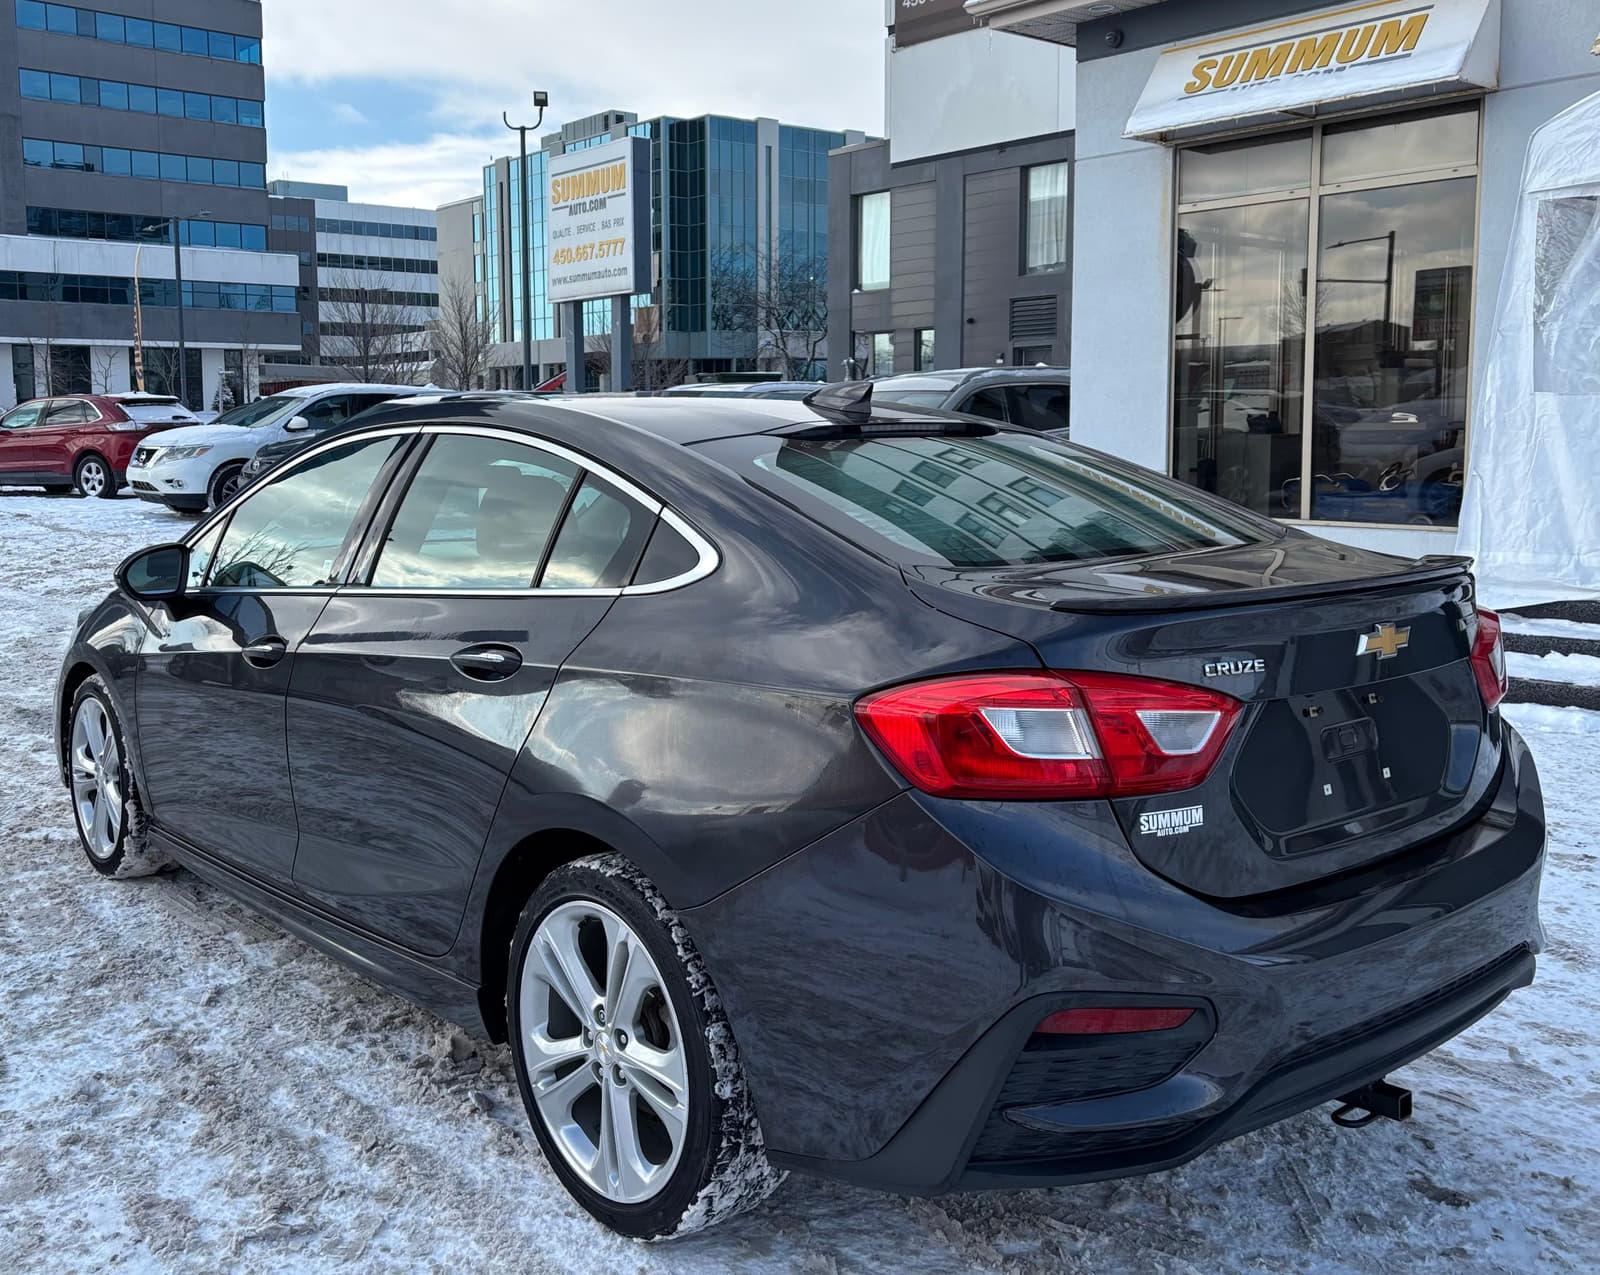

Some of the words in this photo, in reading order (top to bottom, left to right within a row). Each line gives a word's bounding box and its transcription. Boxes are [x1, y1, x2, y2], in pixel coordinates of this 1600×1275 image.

[1184, 14, 1429, 94] SUMMUM
[552, 163, 625, 204] SUMMUM
[568, 197, 607, 216] AUTO.COM
[576, 222, 596, 235] SERVICE
[552, 238, 625, 265] 450.667.5777
[552, 267, 628, 286] www.summumauto.com
[1204, 659, 1265, 677] CRUZE
[1139, 807, 1204, 832] SUMMUM
[1157, 825, 1189, 837] AUTO.COM
